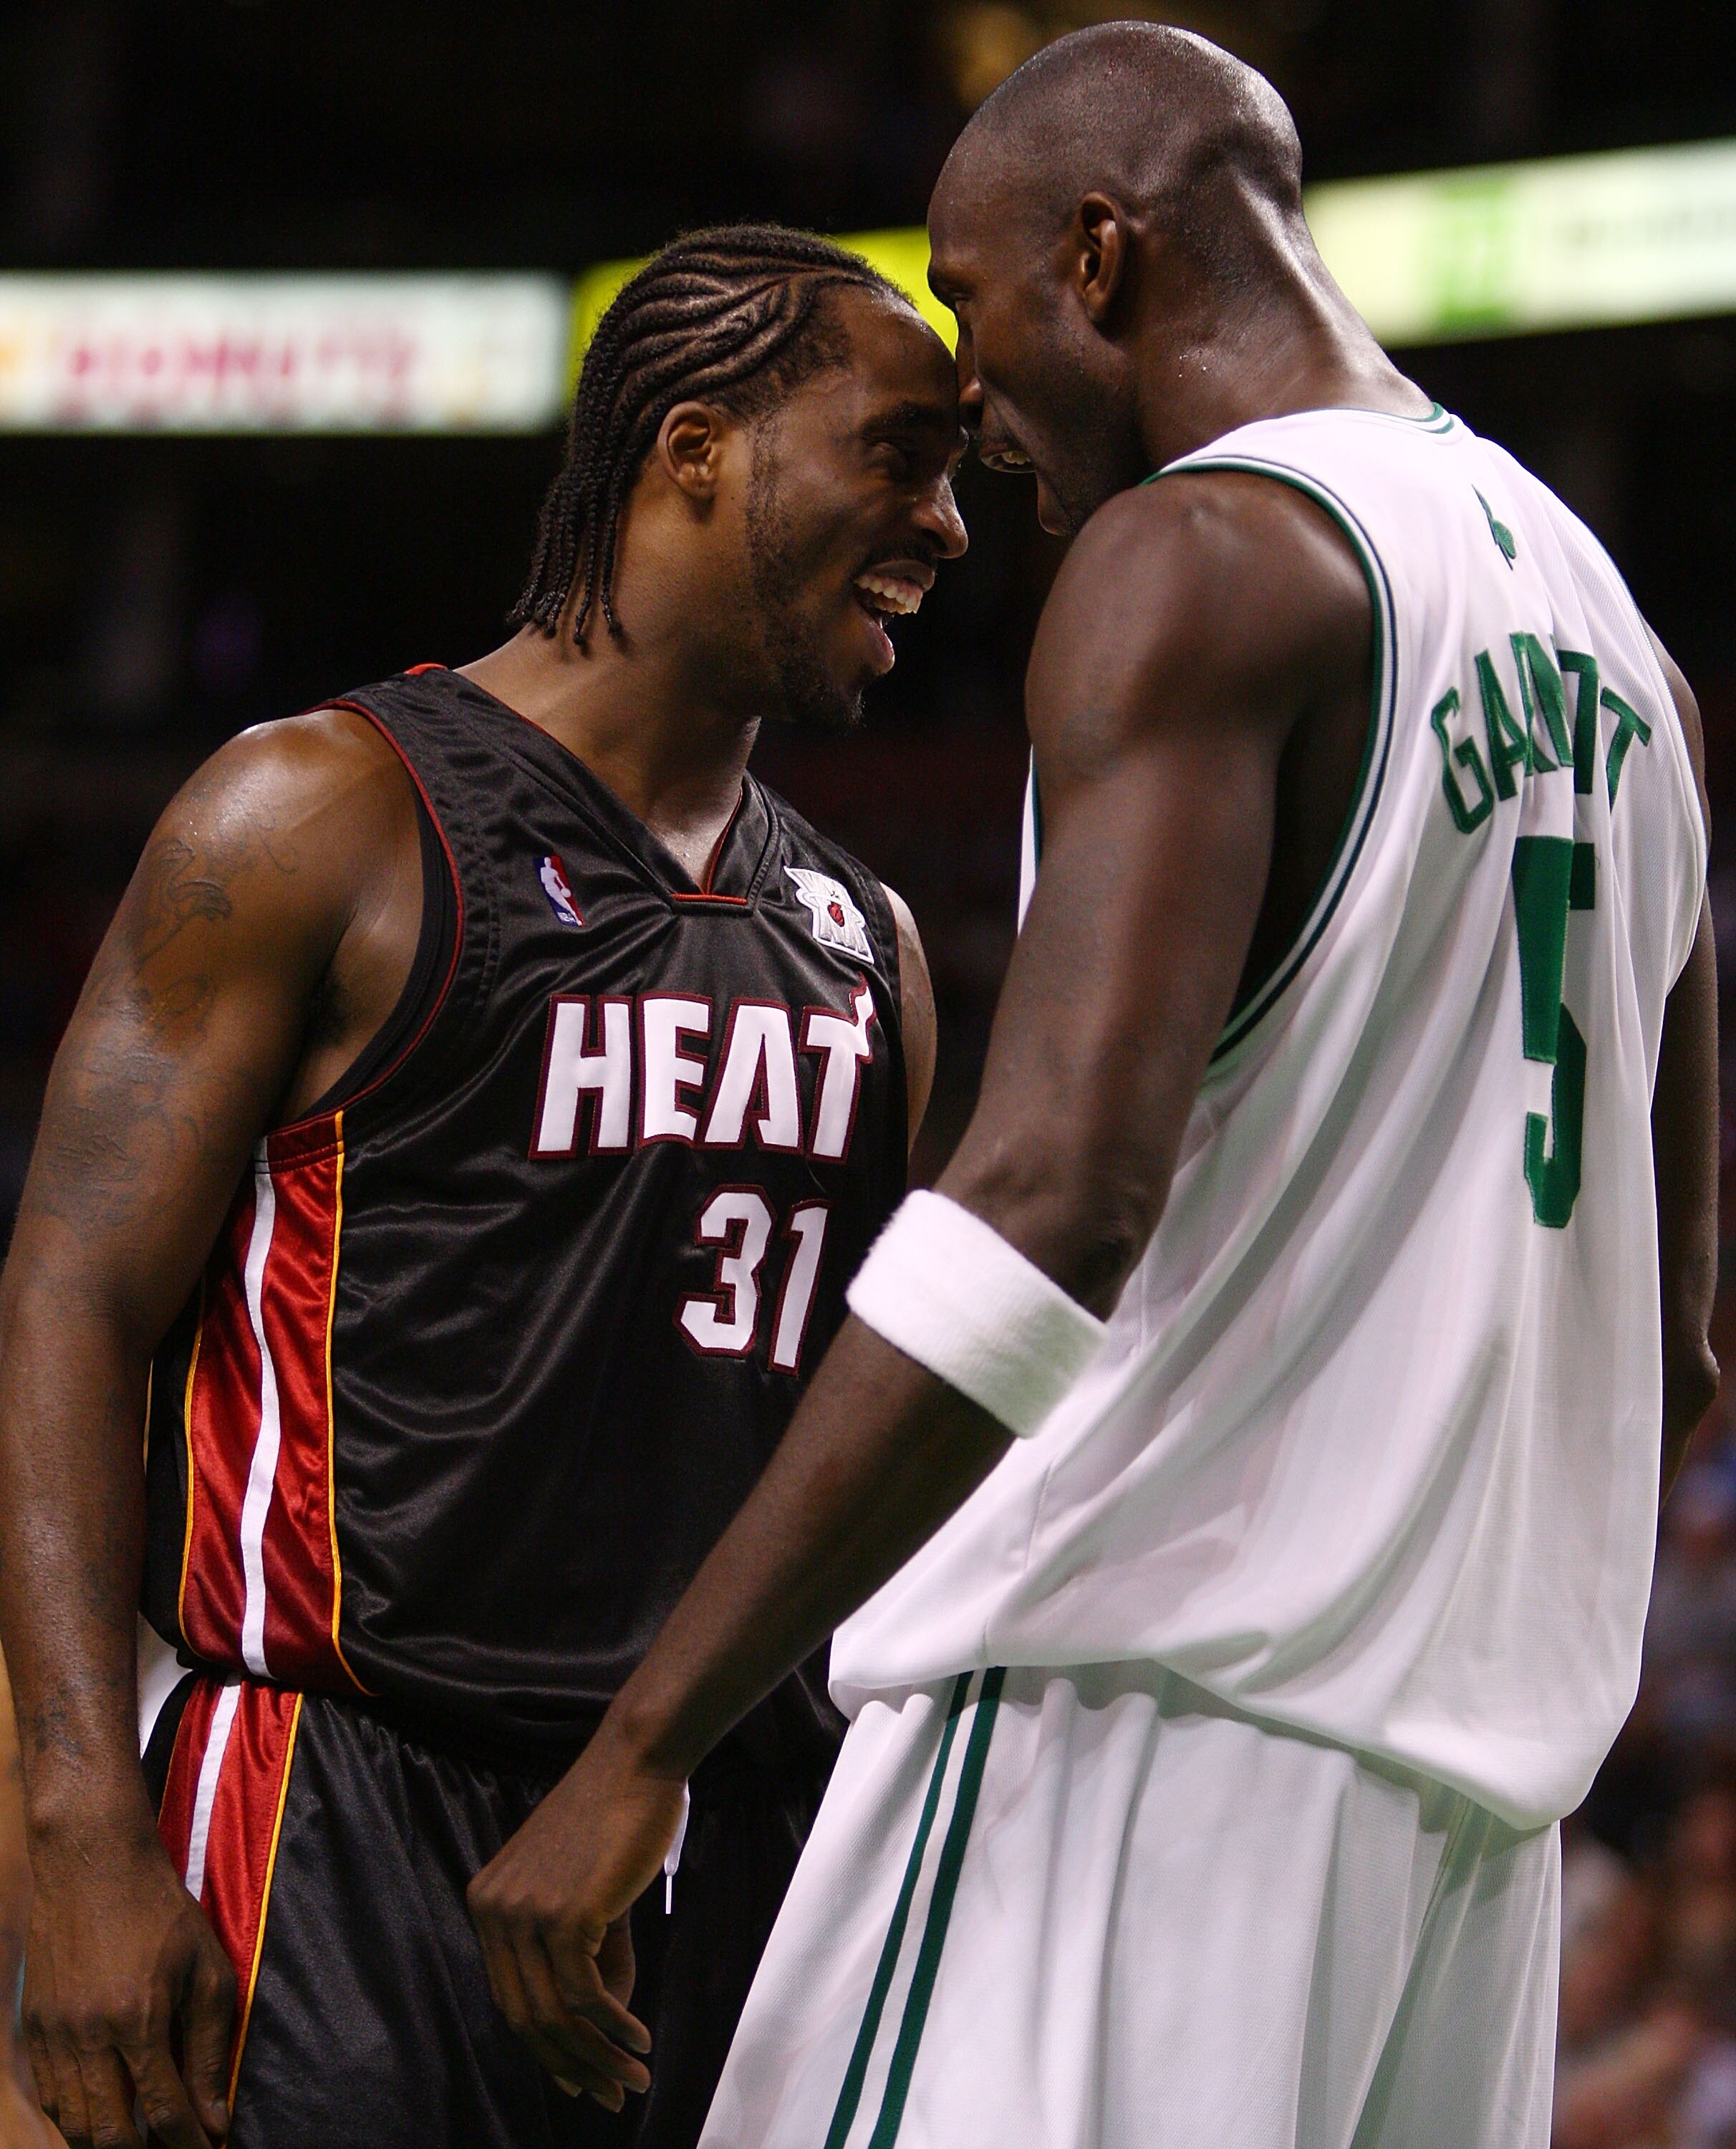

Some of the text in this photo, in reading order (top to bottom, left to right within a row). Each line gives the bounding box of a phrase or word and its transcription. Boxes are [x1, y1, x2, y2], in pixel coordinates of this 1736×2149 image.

[529, 972, 876, 1165] HEAT
[1512, 835, 1595, 1228] 5
[672, 1183, 834, 1378] 31
